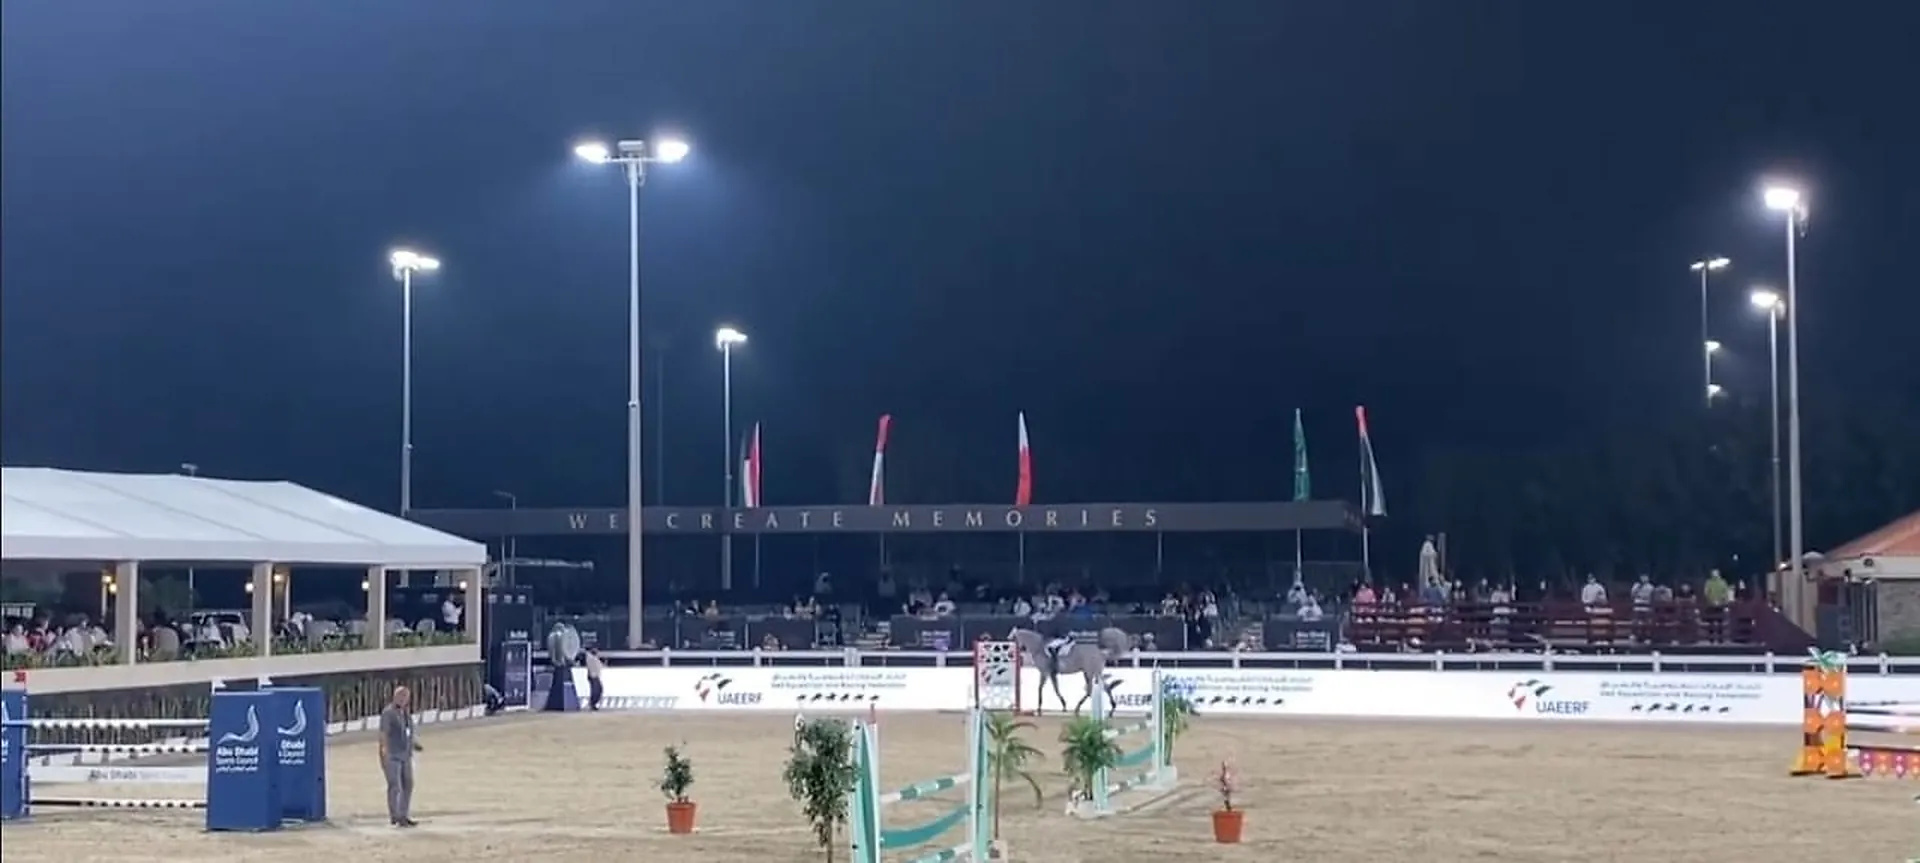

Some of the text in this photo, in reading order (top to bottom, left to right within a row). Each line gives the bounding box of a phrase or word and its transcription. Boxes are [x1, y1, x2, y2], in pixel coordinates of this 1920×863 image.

[569, 509, 1157, 529] WE CREATE MEMORIES
[717, 692, 763, 705] UAEERF
[1536, 701, 1590, 714] UAEERF
[216, 746, 258, 756] Abu Dhabi
